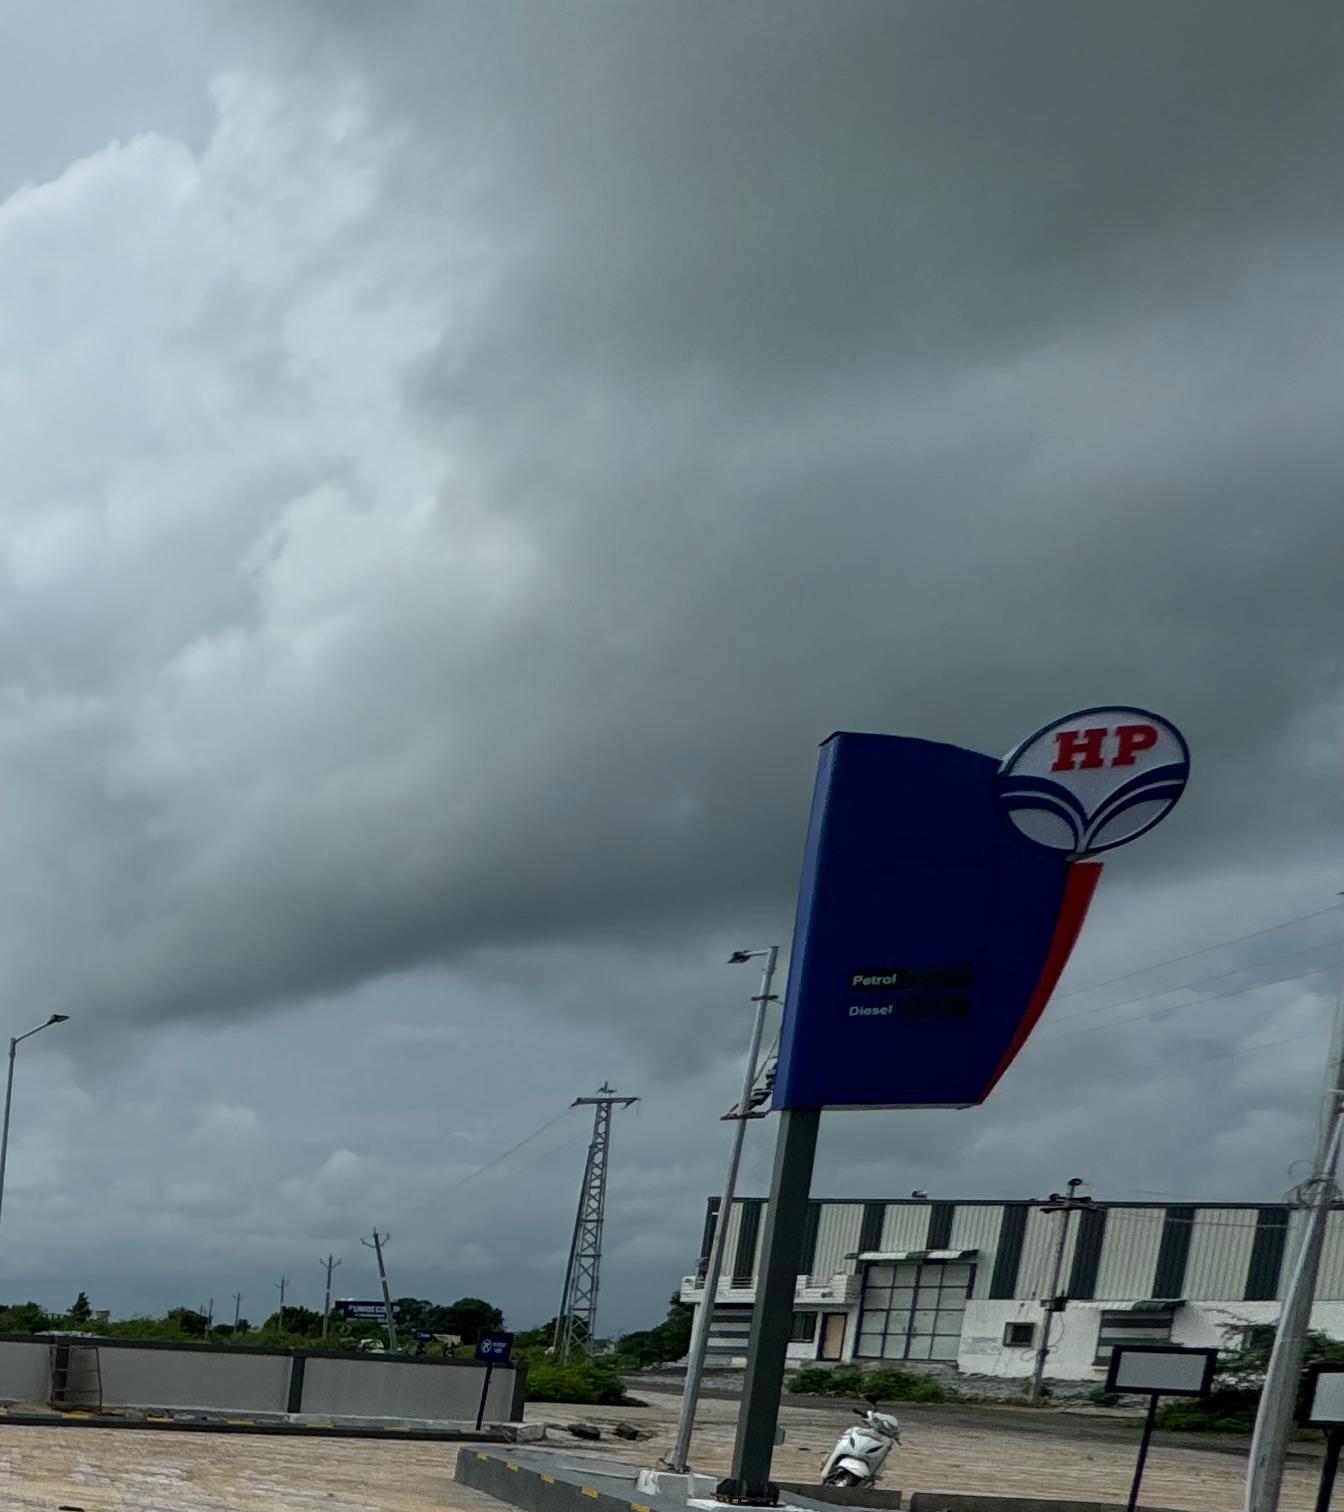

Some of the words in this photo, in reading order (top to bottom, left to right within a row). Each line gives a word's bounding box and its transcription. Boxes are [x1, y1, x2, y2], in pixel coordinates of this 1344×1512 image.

[1051, 725, 1158, 772] HP
[852, 974, 897, 986] Petrol
[848, 1004, 893, 1016] Diesel
